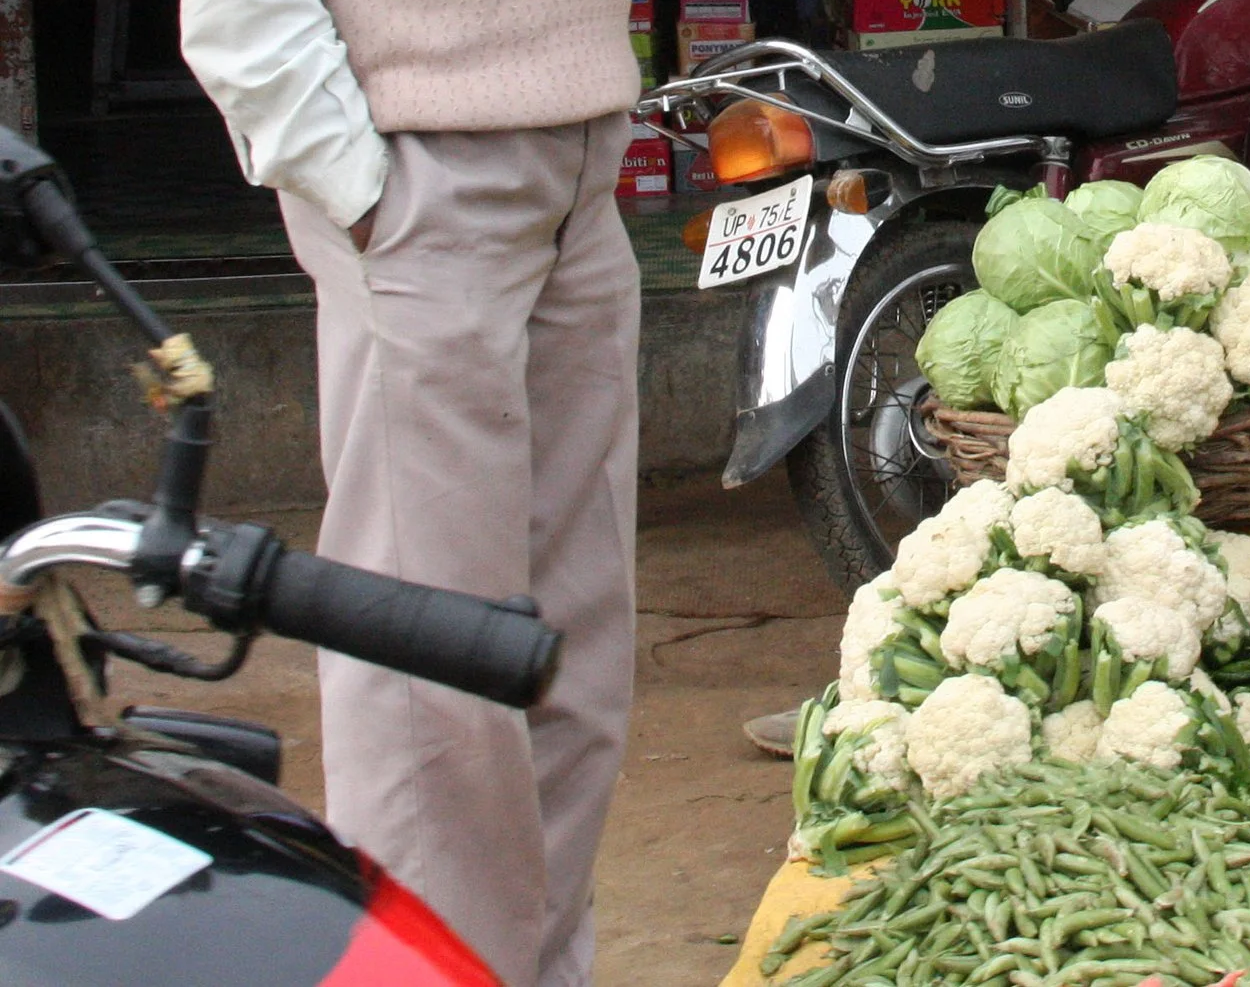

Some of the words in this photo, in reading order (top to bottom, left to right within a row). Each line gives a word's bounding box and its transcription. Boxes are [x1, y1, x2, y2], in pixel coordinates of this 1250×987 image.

[1002, 95, 1029, 105] SUNIL
[621, 156, 667, 168] bition
[723, 213, 747, 238] UP
[710, 224, 797, 279] 4806
